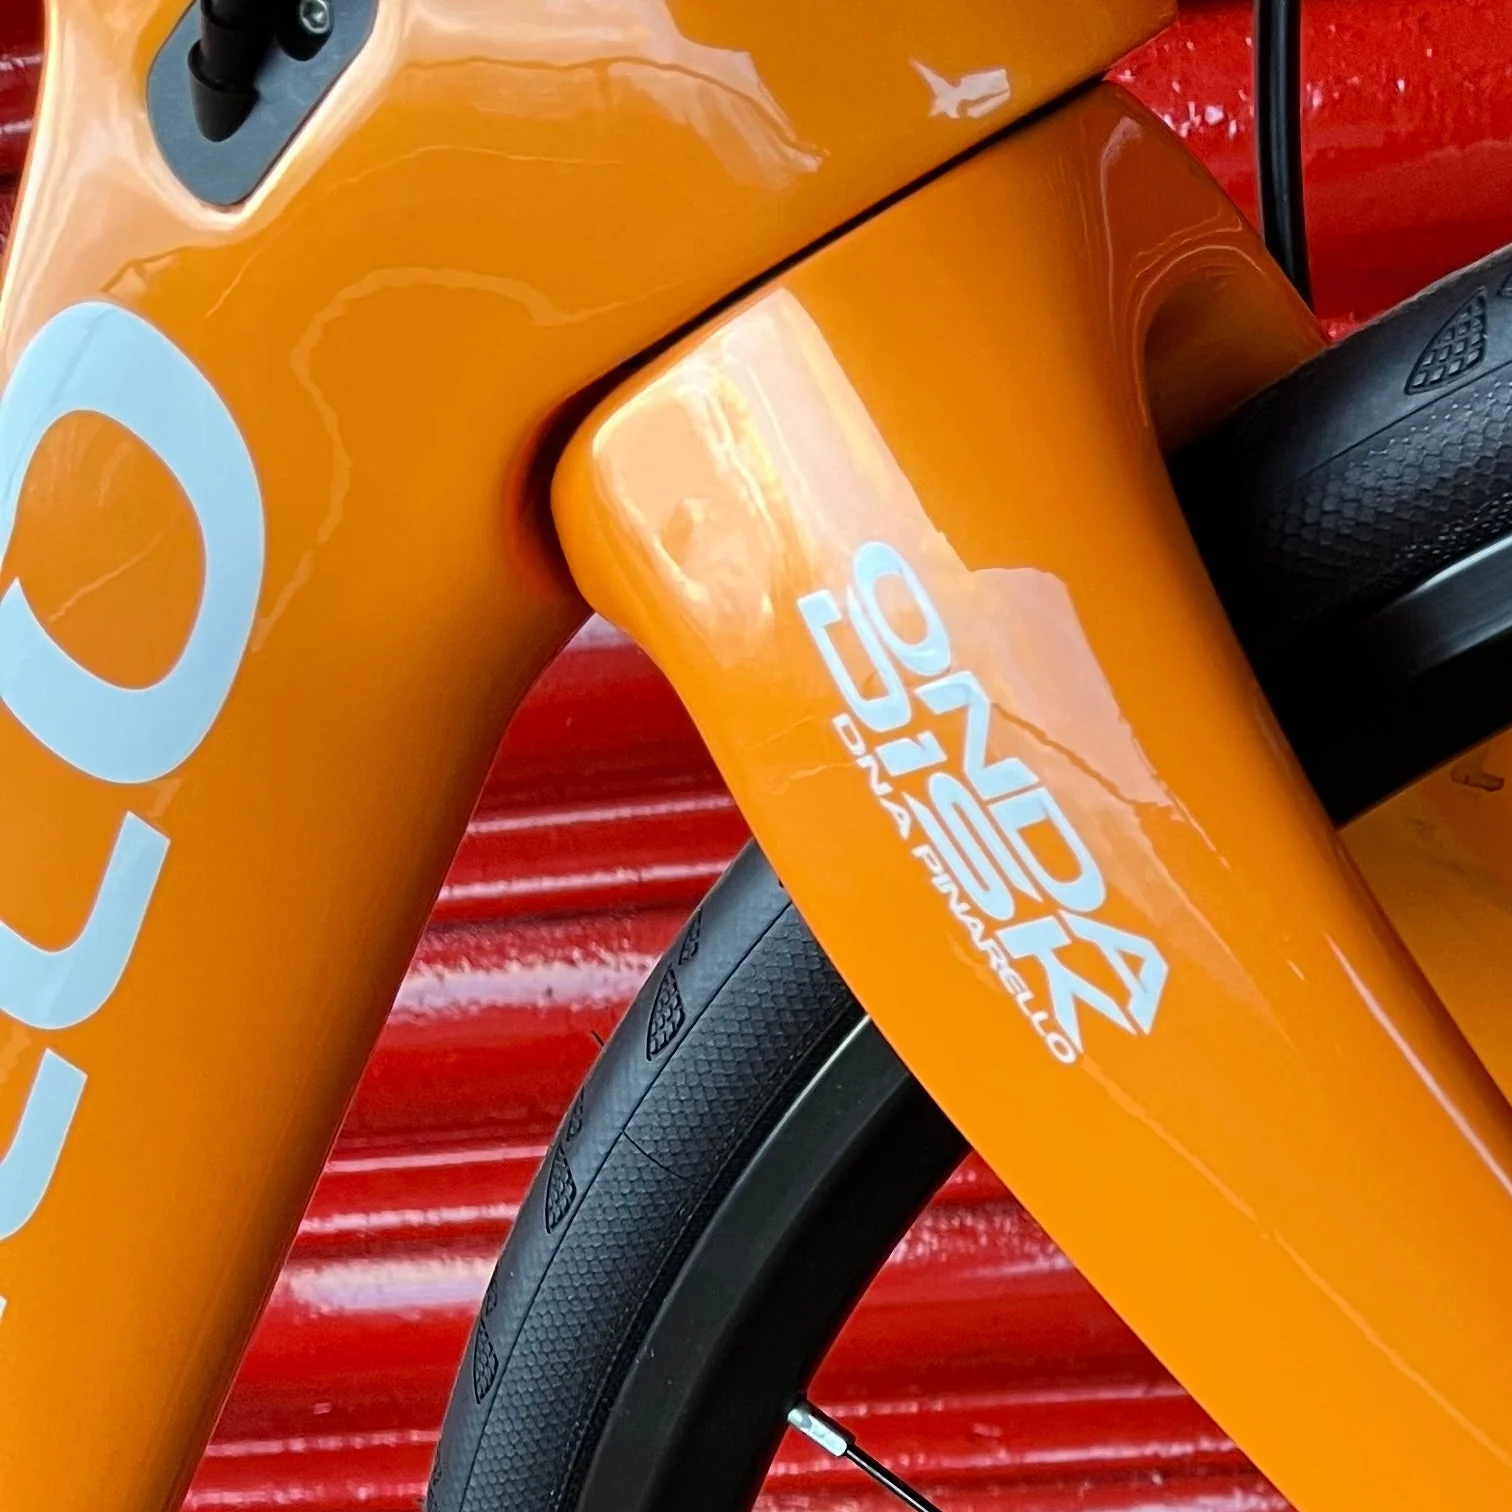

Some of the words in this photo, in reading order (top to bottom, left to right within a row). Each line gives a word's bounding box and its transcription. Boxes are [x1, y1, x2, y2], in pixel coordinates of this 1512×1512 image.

[832, 712, 912, 840] DNA
[911, 844, 1077, 1064] PINARELLO
[853, 541, 1168, 1036] ONDA
